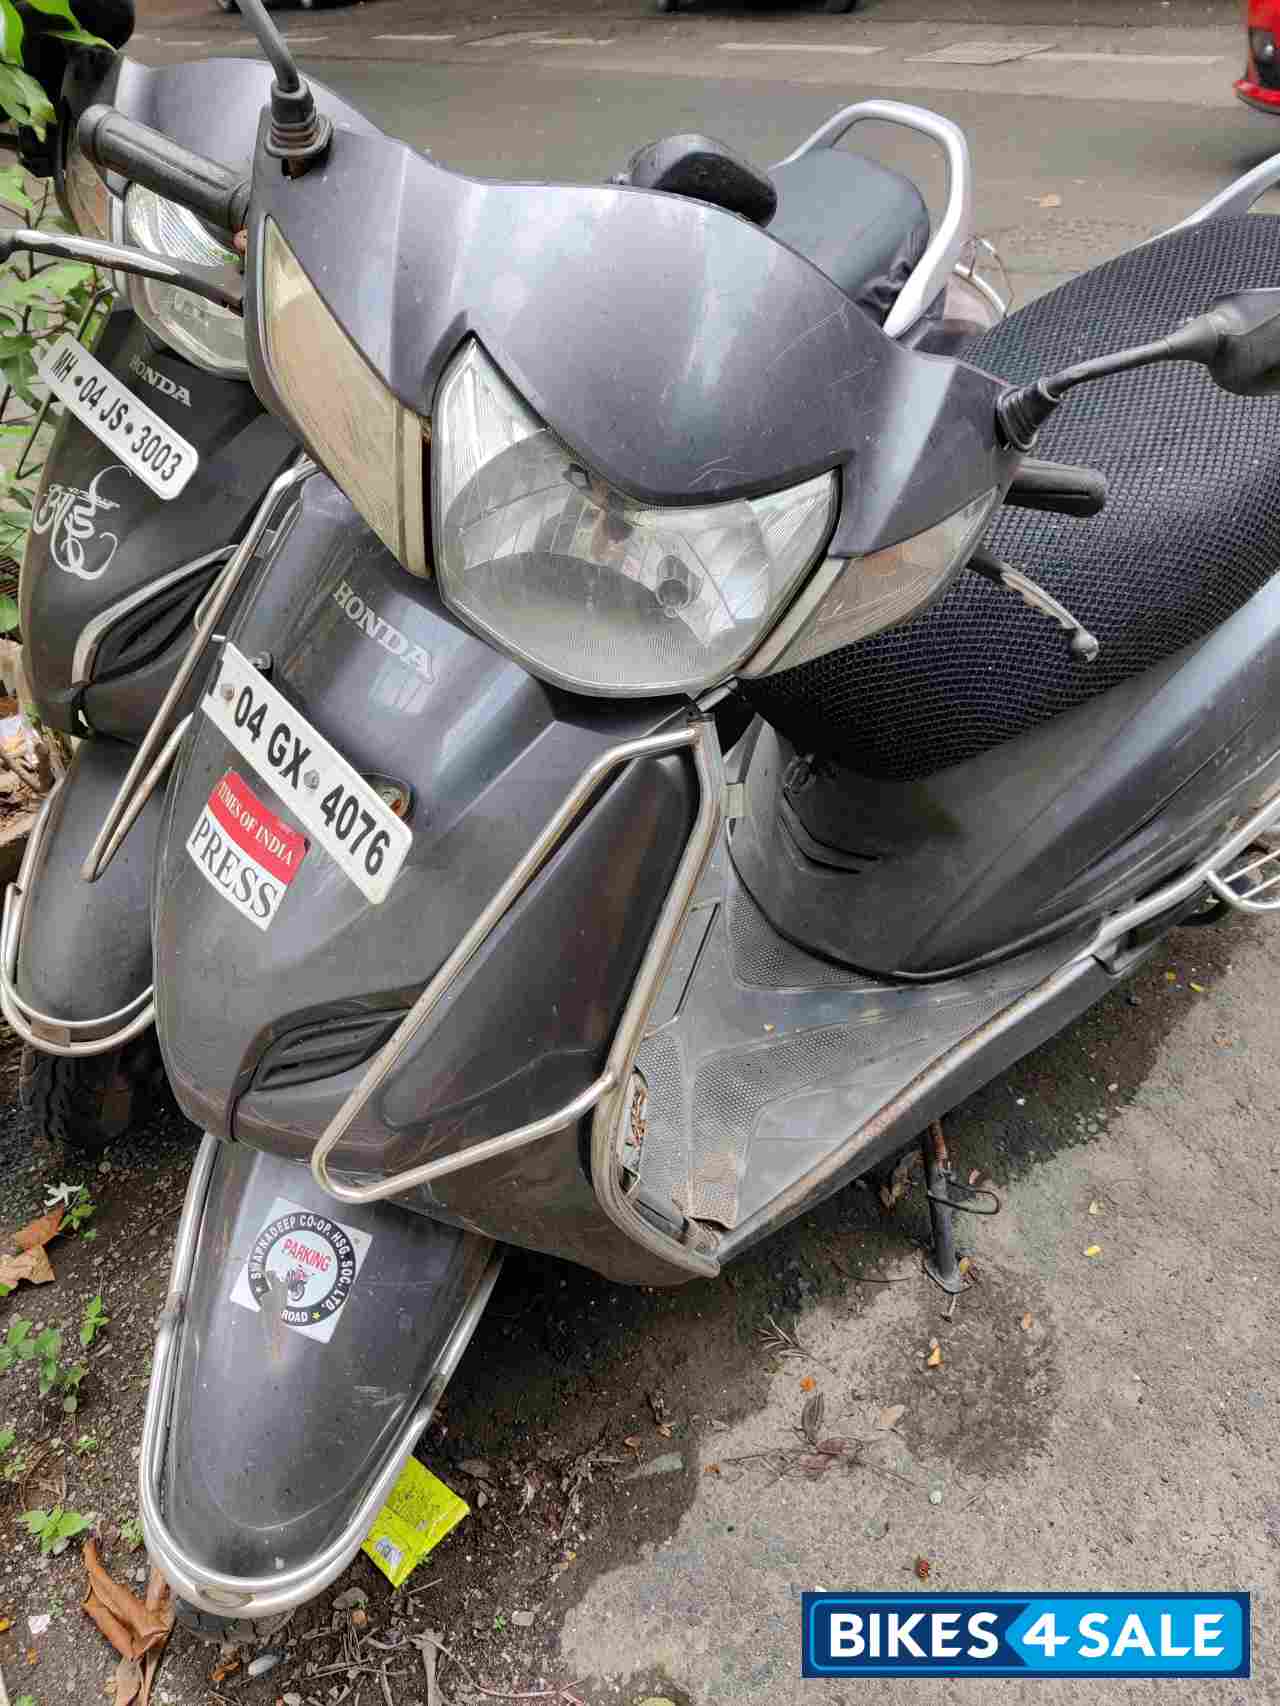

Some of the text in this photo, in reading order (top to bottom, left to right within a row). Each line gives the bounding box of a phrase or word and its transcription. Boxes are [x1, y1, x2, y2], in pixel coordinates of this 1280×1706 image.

[51, 348, 183, 481] MH 04 JS 3003
[129, 353, 192, 408] HONDA
[332, 580, 437, 683] HONDA
[216, 781, 296, 866] TIMES OF INDIA
[233, 685, 391, 877] 04 GX 4076
[191, 817, 278, 918] PRESS
[283, 1238, 332, 1272] PARKING
[280, 1309, 308, 1322] ROAD
